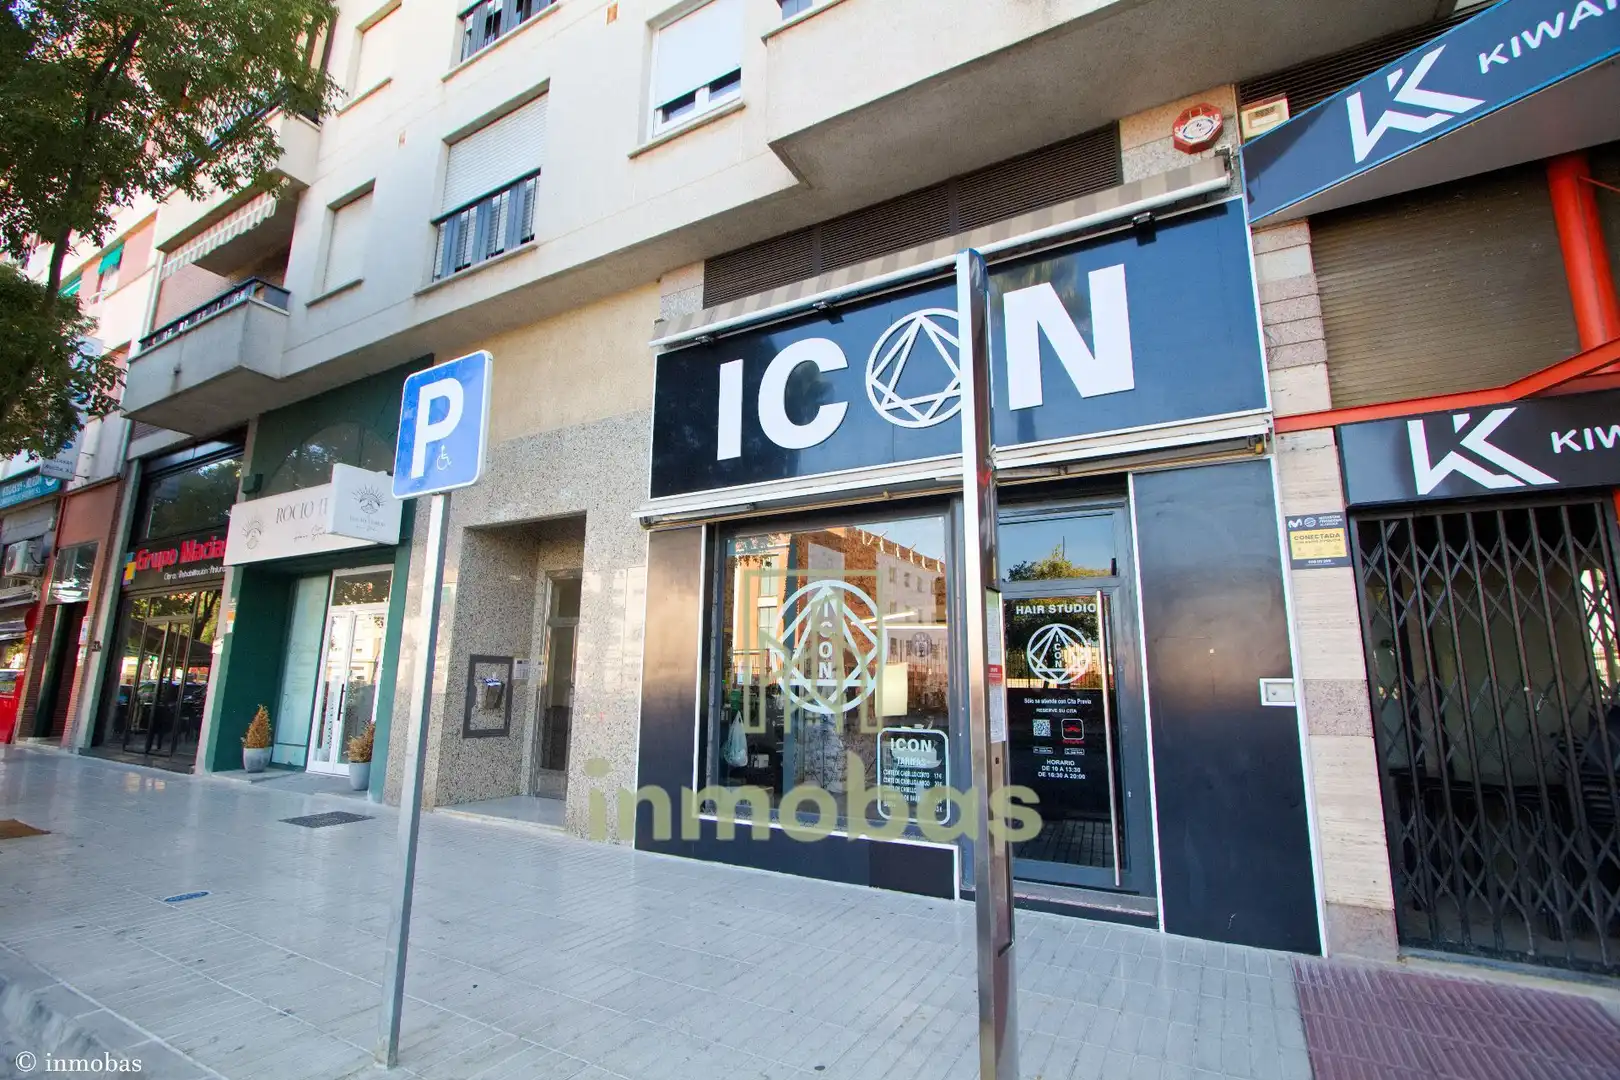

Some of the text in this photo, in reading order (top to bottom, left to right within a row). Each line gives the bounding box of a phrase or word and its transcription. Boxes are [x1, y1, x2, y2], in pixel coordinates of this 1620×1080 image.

[411, 377, 464, 479] P
[1293, 533, 1341, 541] CONECTADA
[135, 548, 178, 572] Grupo
[1015, 603, 1097, 615] HAIR STUDIO
[1053, 634, 1063, 668] ICON
[890, 738, 932, 752] ICON
